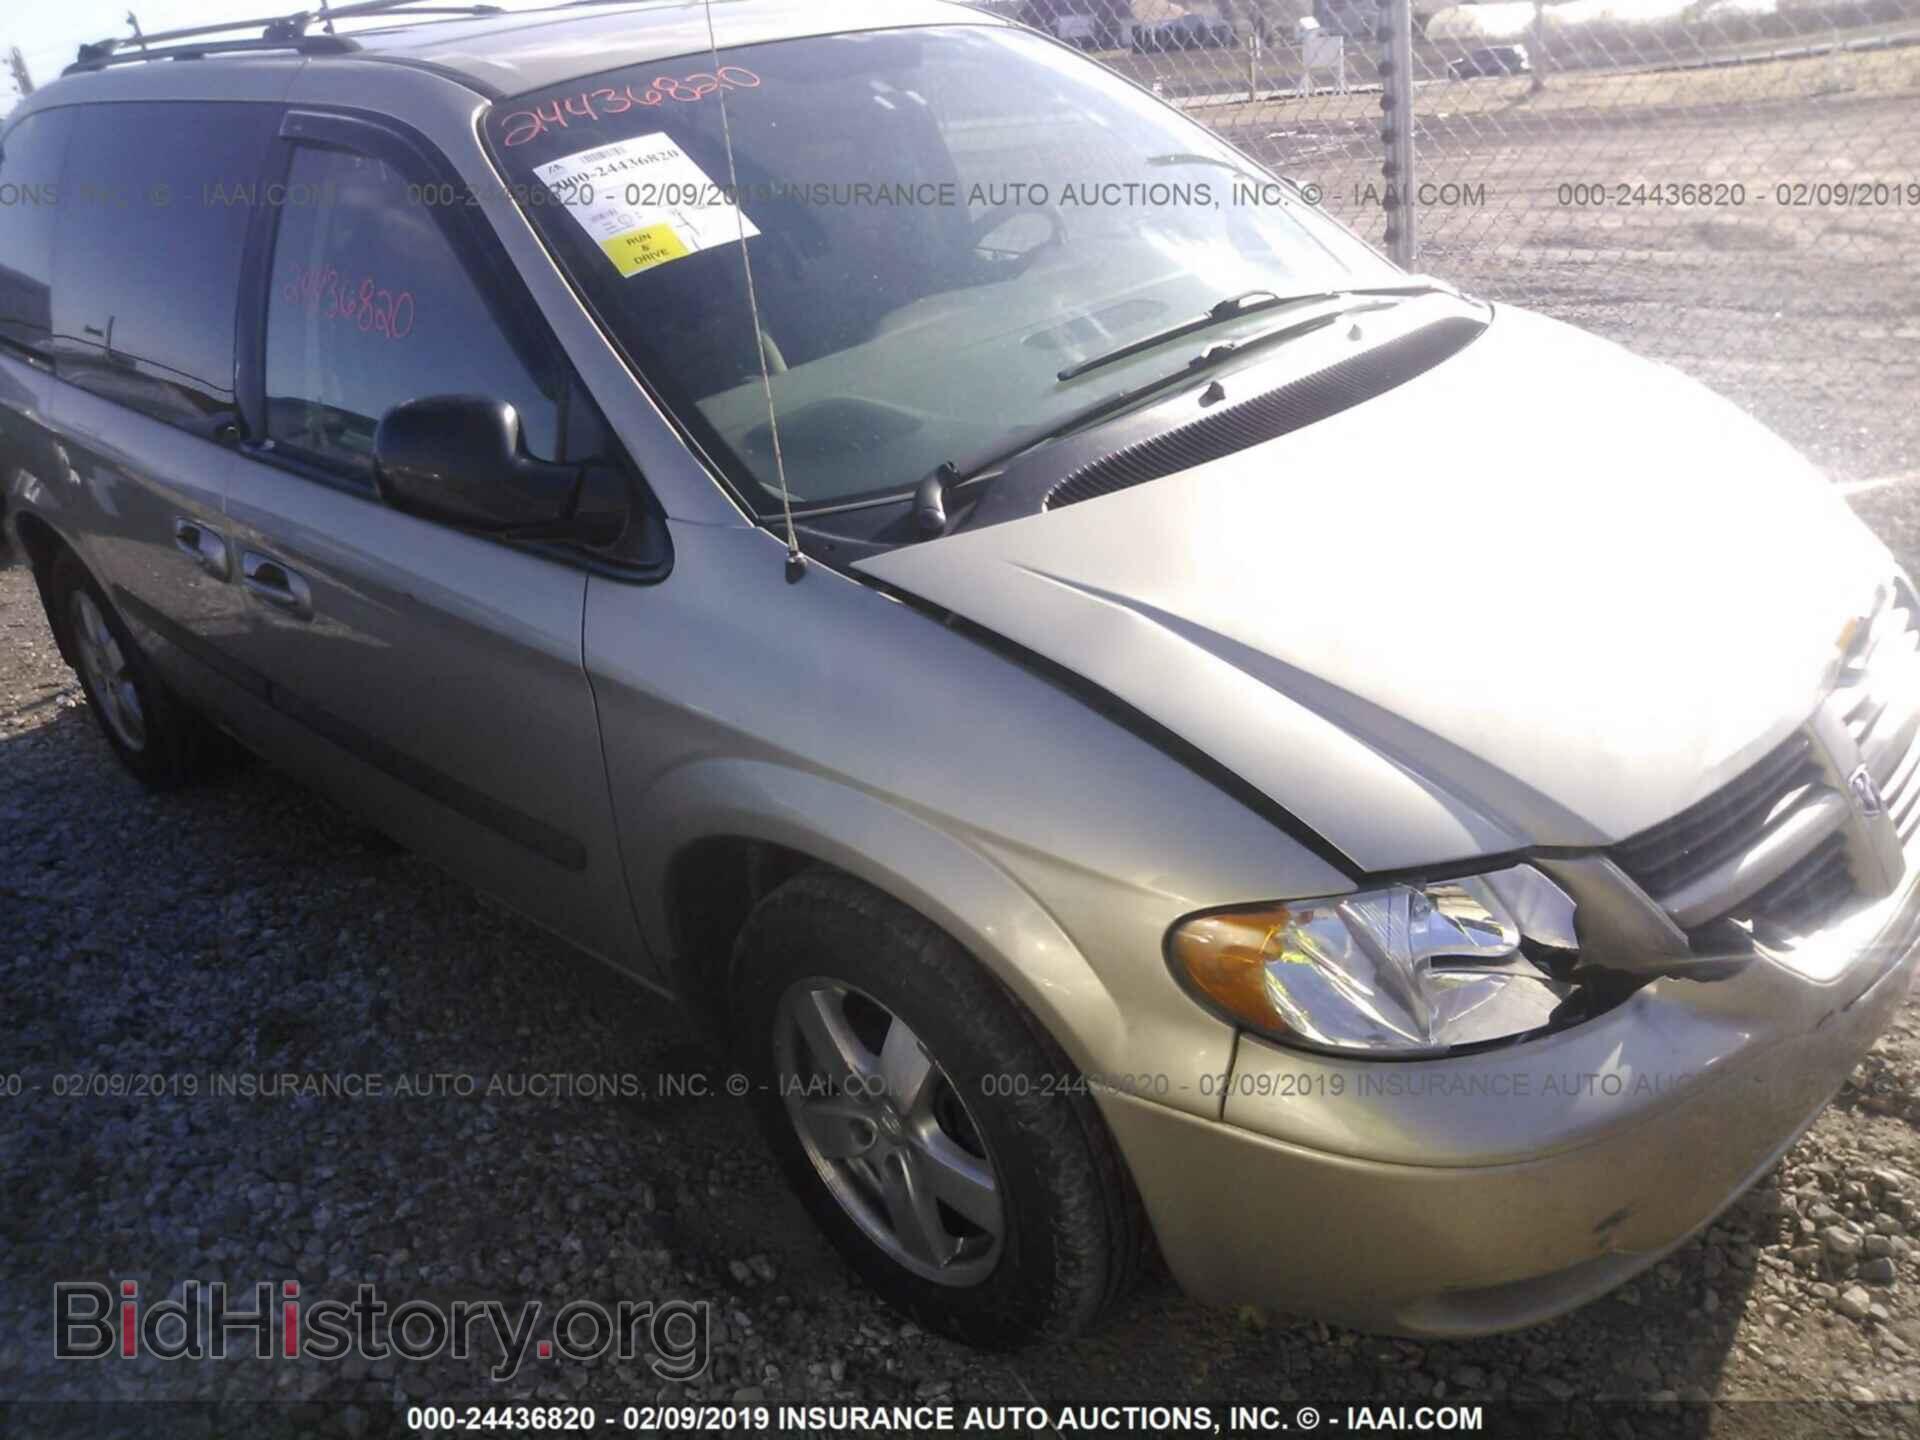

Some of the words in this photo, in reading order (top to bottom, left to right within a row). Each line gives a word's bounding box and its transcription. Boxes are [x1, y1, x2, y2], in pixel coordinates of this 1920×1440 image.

[502, 66, 760, 146] 24436820
[626, 233, 652, 247] RUN
[633, 248, 671, 265] DRIVE
